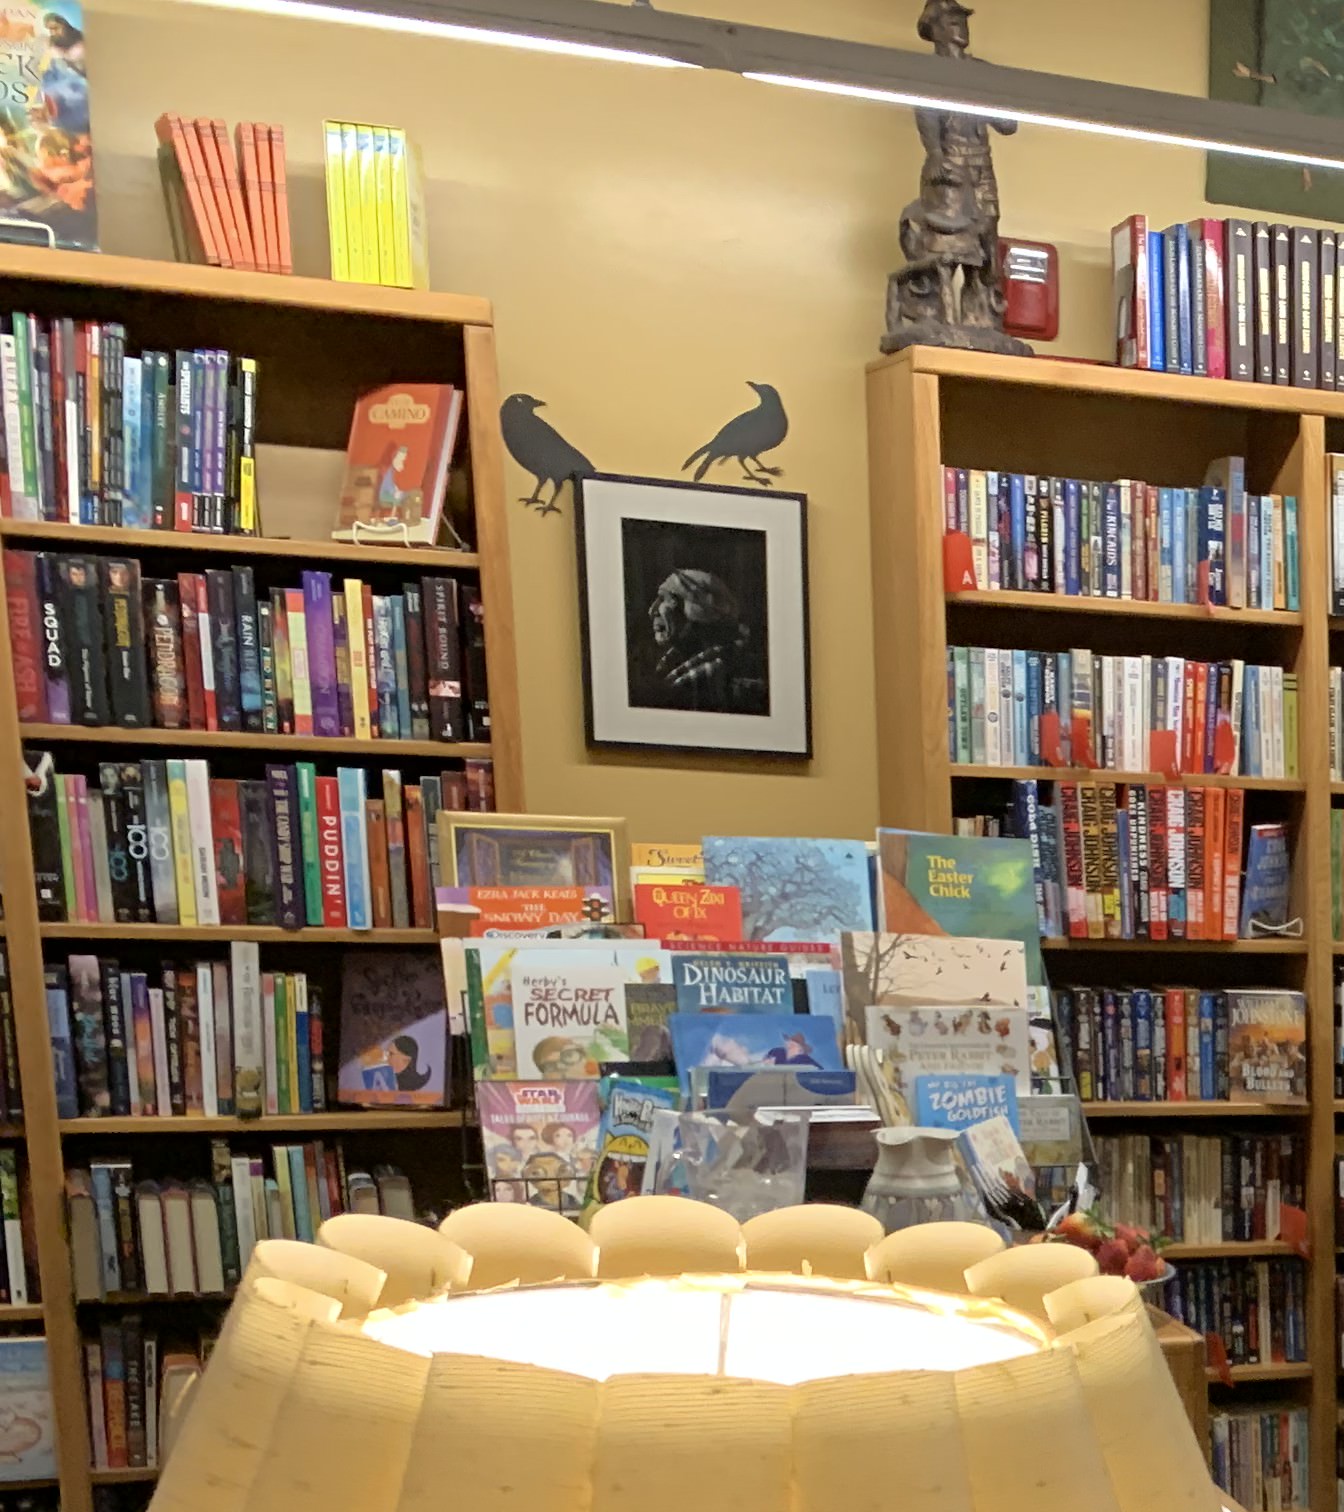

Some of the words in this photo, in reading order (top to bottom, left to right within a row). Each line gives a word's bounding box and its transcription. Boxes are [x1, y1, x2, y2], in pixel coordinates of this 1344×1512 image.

[43, 602, 62, 667] SQUAD
[1081, 787, 1099, 826] CRAIG
[1099, 787, 1116, 824] CRAIG
[1167, 790, 1184, 827] CRAIG
[1138, 802, 1148, 867] KINDNESS
[926, 855, 956, 869] The
[1083, 830, 1101, 893] JOHNSON
[1101, 827, 1119, 888] JOHNSON
[1167, 829, 1184, 888] JOHNSON
[927, 870, 975, 885] Easter
[929, 884, 971, 899] Chick
[684, 963, 787, 986] DINOSAUR
[530, 987, 615, 1002] SECRET
[699, 983, 786, 1005] HABITAT
[523, 1002, 620, 1028] FORMULA
[929, 1084, 1007, 1111] ZOMBIE
